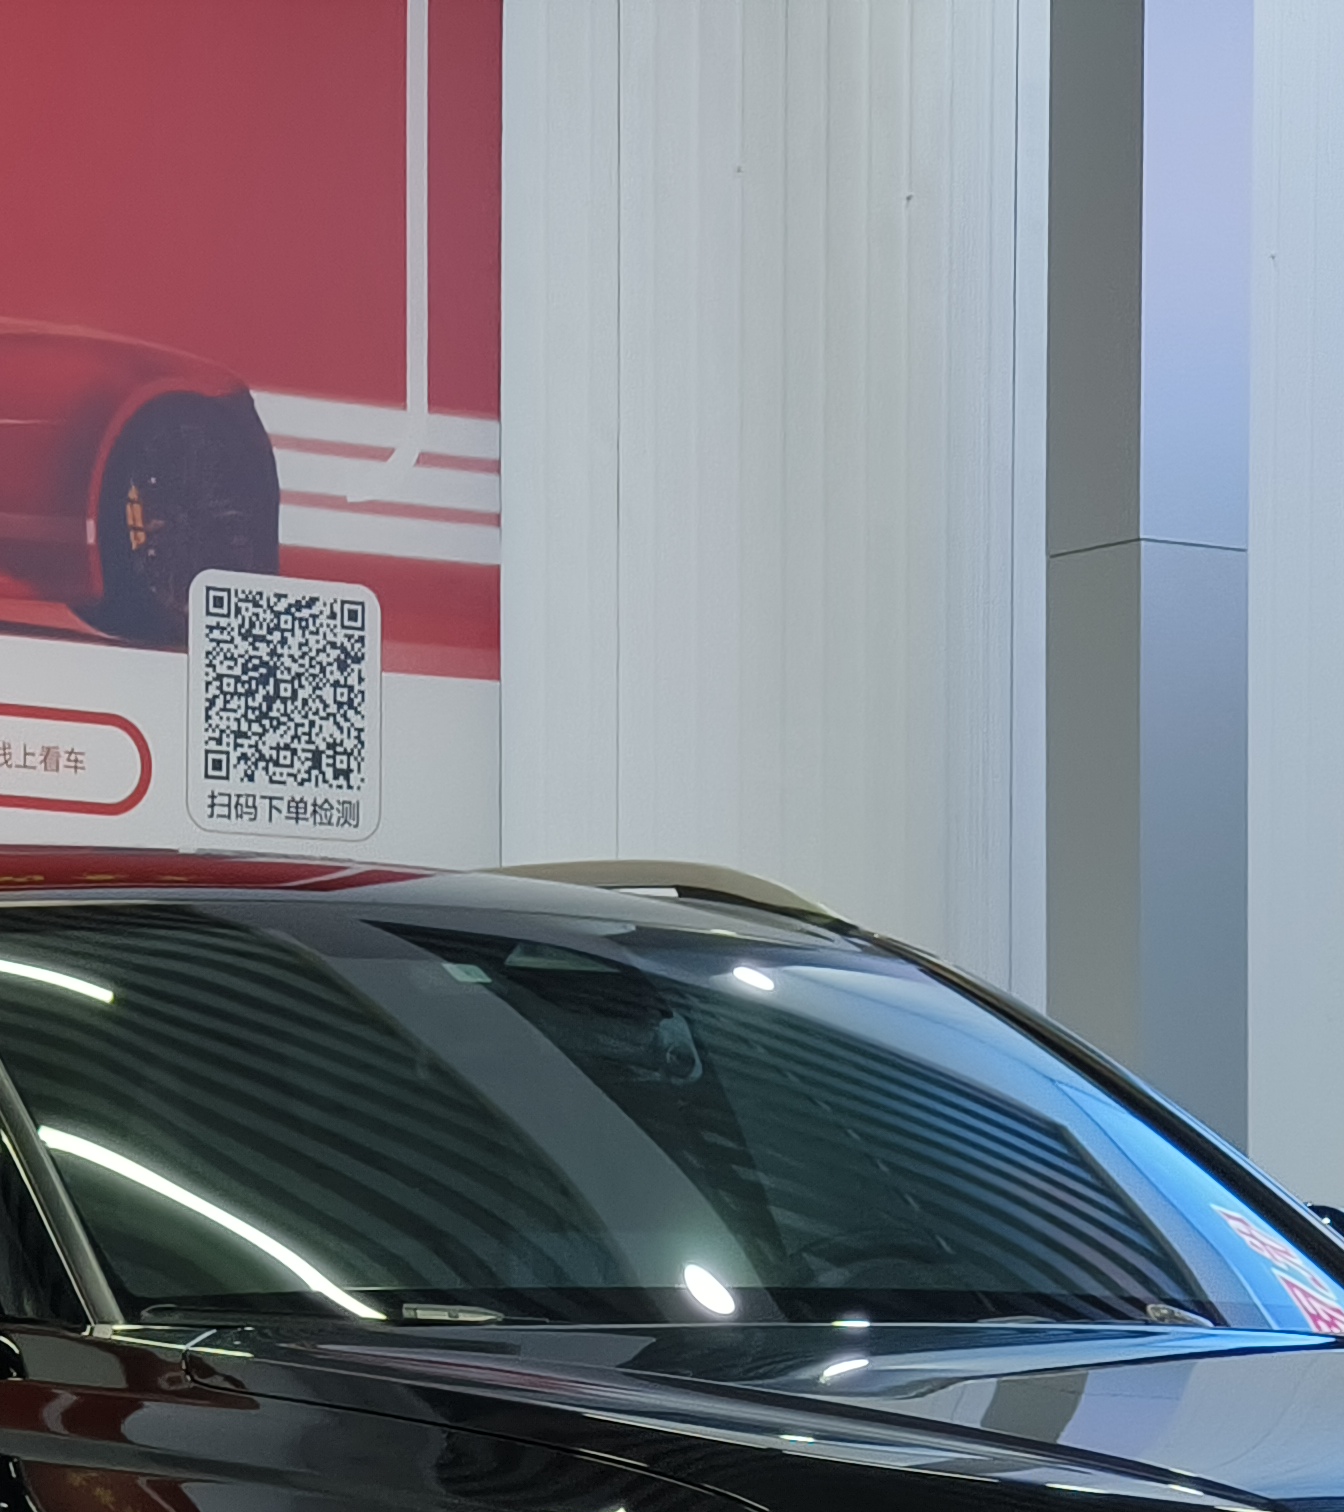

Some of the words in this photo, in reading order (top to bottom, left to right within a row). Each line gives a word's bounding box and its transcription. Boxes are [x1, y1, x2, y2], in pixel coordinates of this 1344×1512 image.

[206, 789, 361, 829] 扫码下单检测
